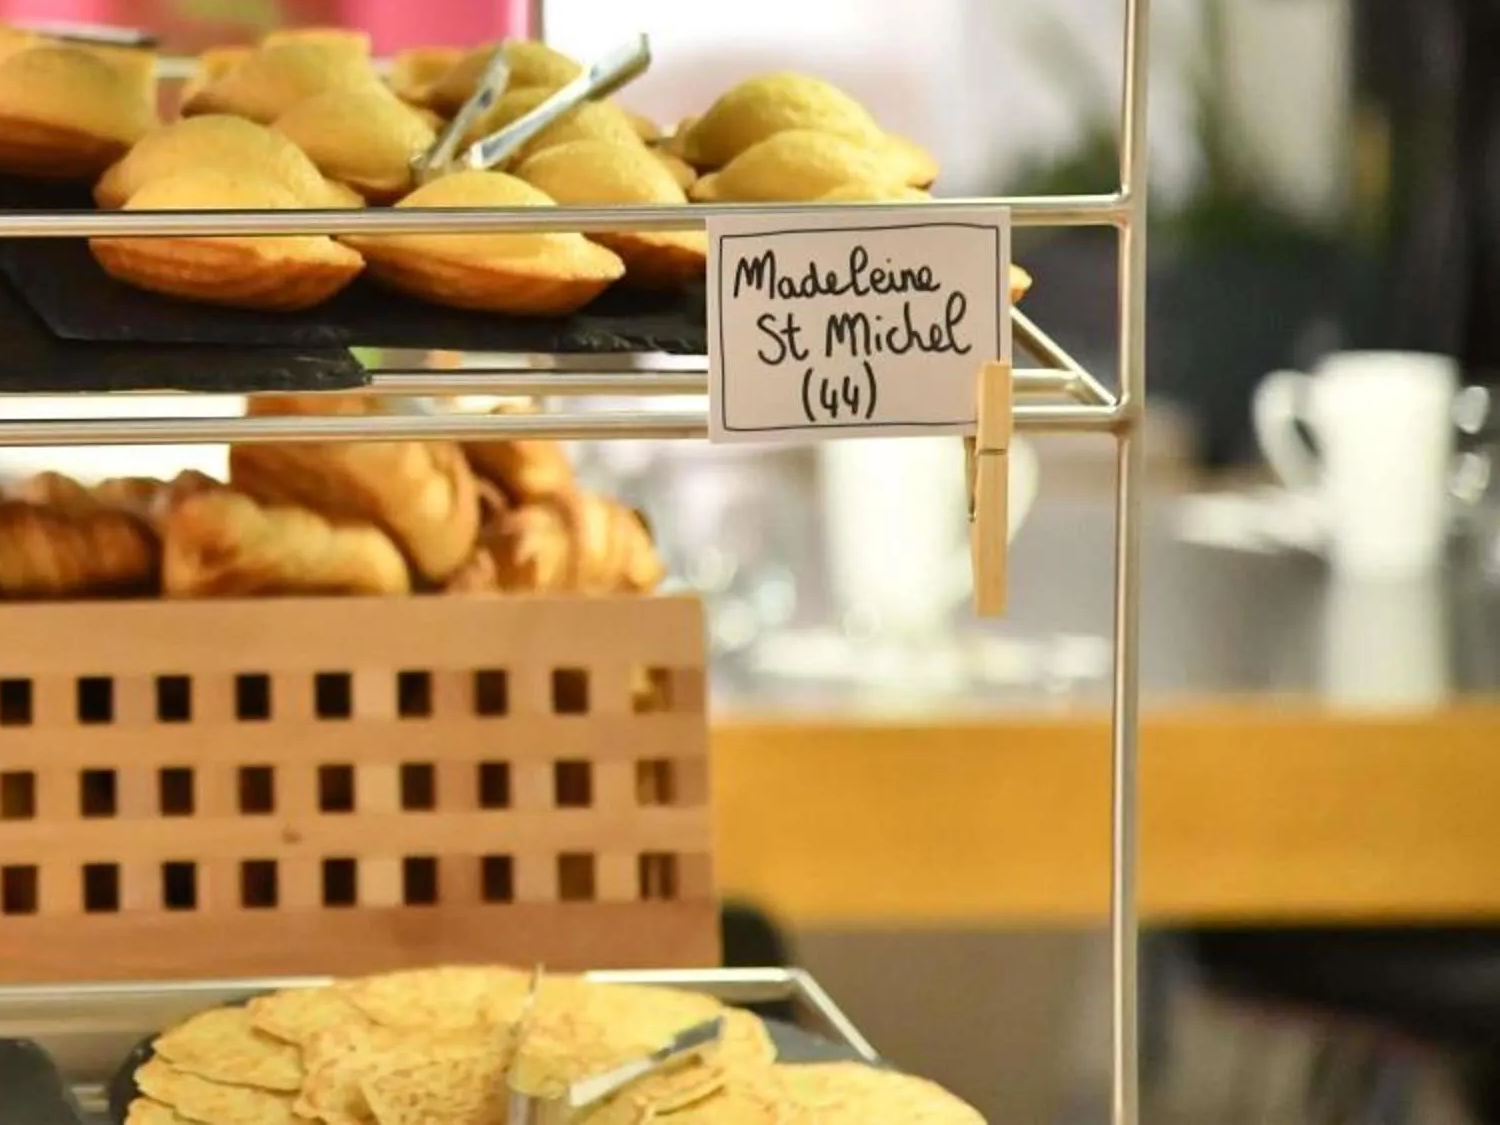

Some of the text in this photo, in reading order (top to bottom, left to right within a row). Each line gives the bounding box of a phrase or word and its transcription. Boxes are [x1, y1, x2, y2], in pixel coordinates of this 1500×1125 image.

[733, 245, 941, 300] Madeleine
[756, 291, 973, 366] St Michel
[802, 360, 877, 422] (44)
